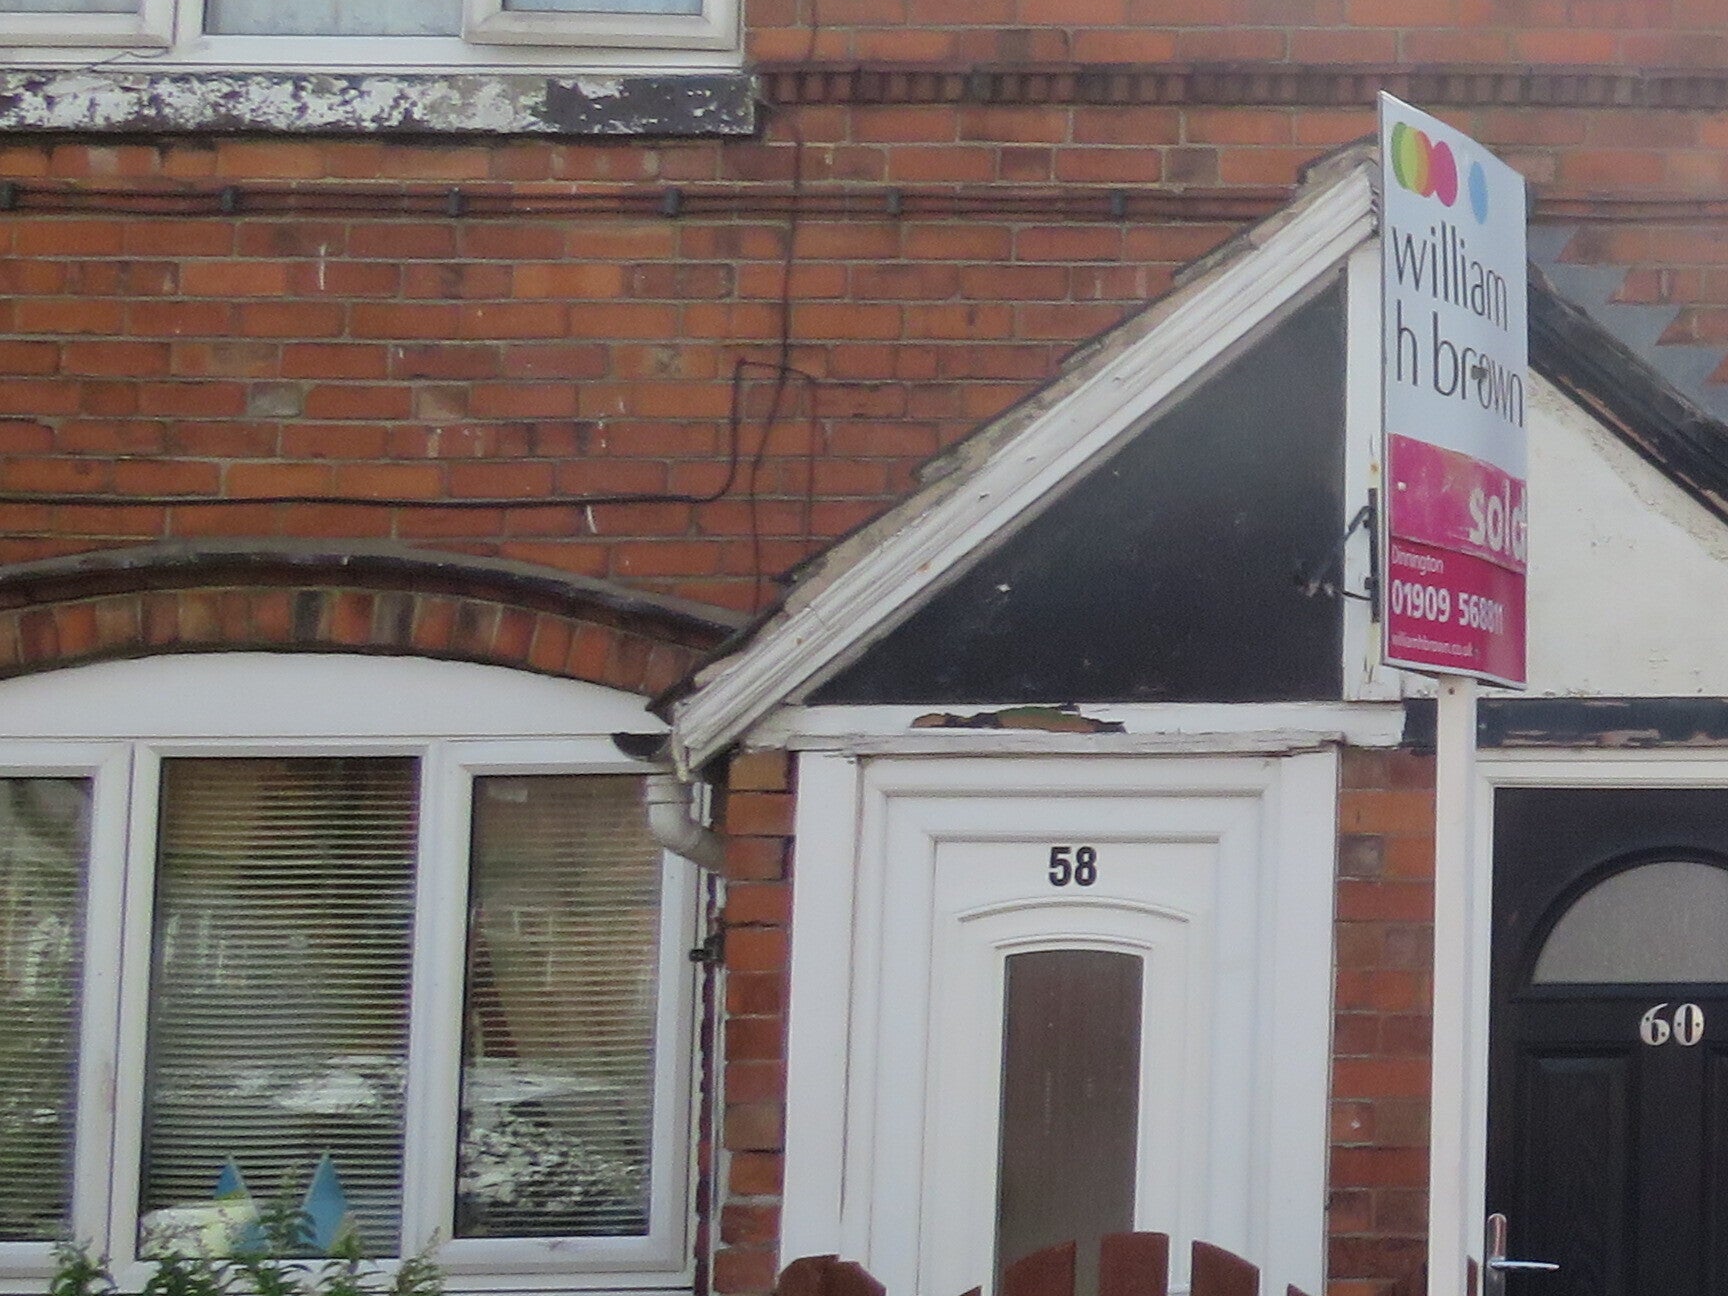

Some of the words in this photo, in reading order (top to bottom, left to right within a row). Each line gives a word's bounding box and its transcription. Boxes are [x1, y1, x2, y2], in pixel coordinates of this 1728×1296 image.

[1392, 219, 1507, 332] william
[1397, 299, 1418, 387] h
[1432, 310, 1523, 428] brown
[1469, 480, 1527, 561] sold
[1391, 579, 1450, 623] 01909
[1049, 846, 1097, 886] 58
[1639, 1002, 1705, 1046] 60
